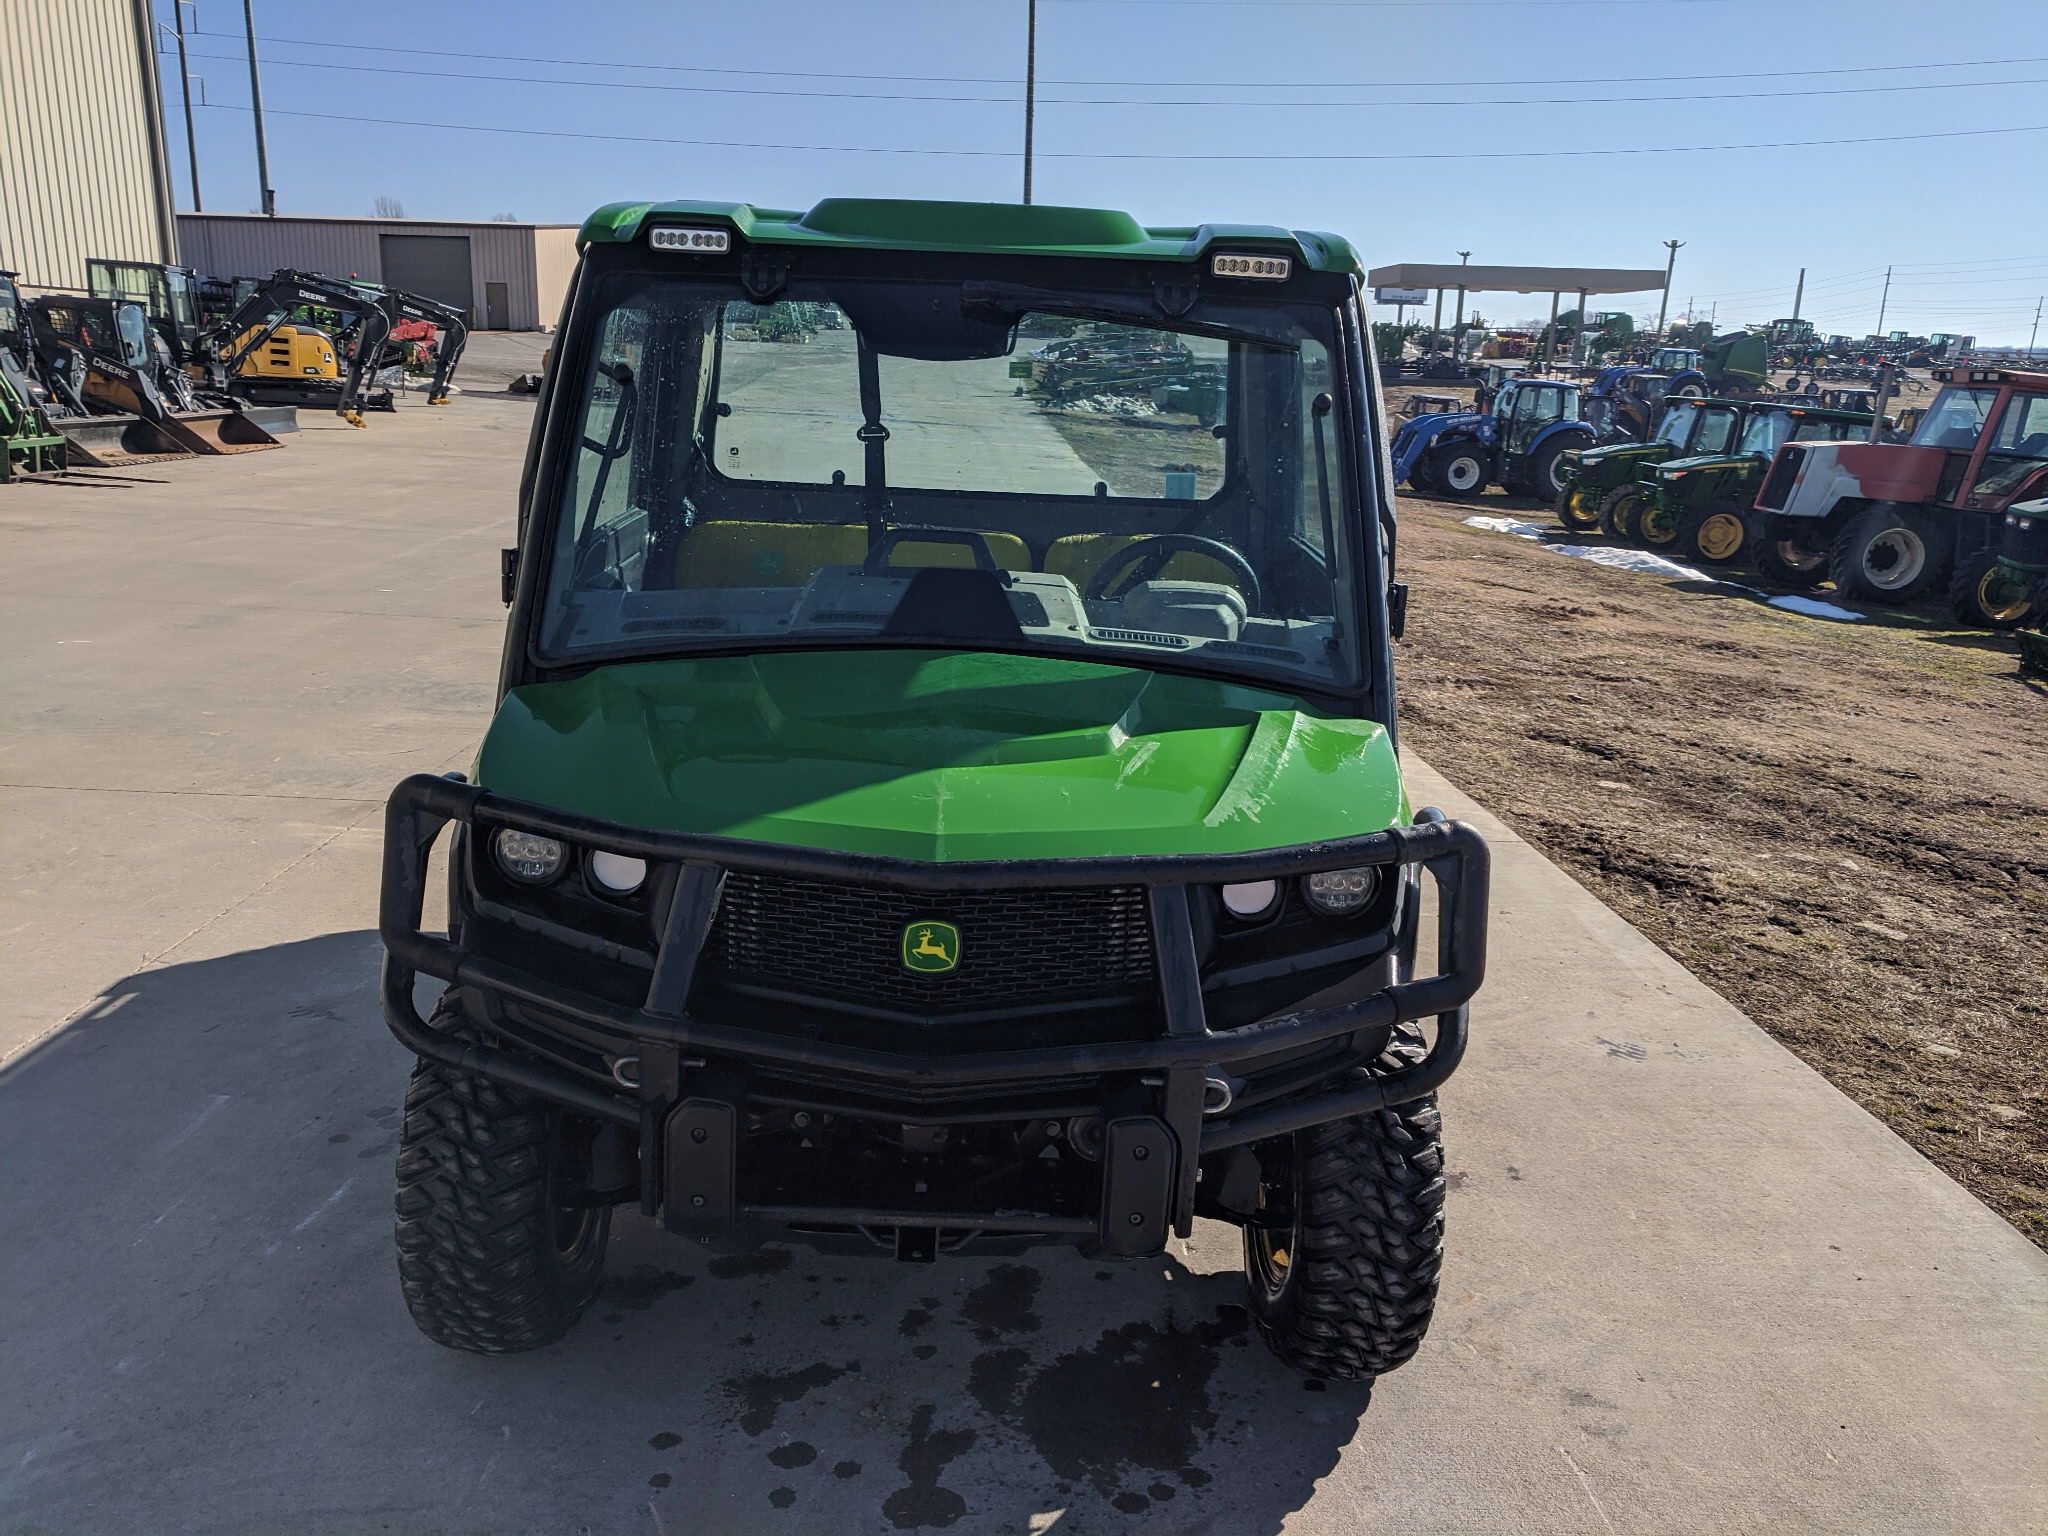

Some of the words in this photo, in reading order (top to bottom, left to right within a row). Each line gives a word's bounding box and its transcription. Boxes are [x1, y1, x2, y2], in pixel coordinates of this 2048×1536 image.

[299, 289, 327, 303] DEERE
[402, 304, 423, 316] DEERE
[92, 356, 130, 379] DEERE
